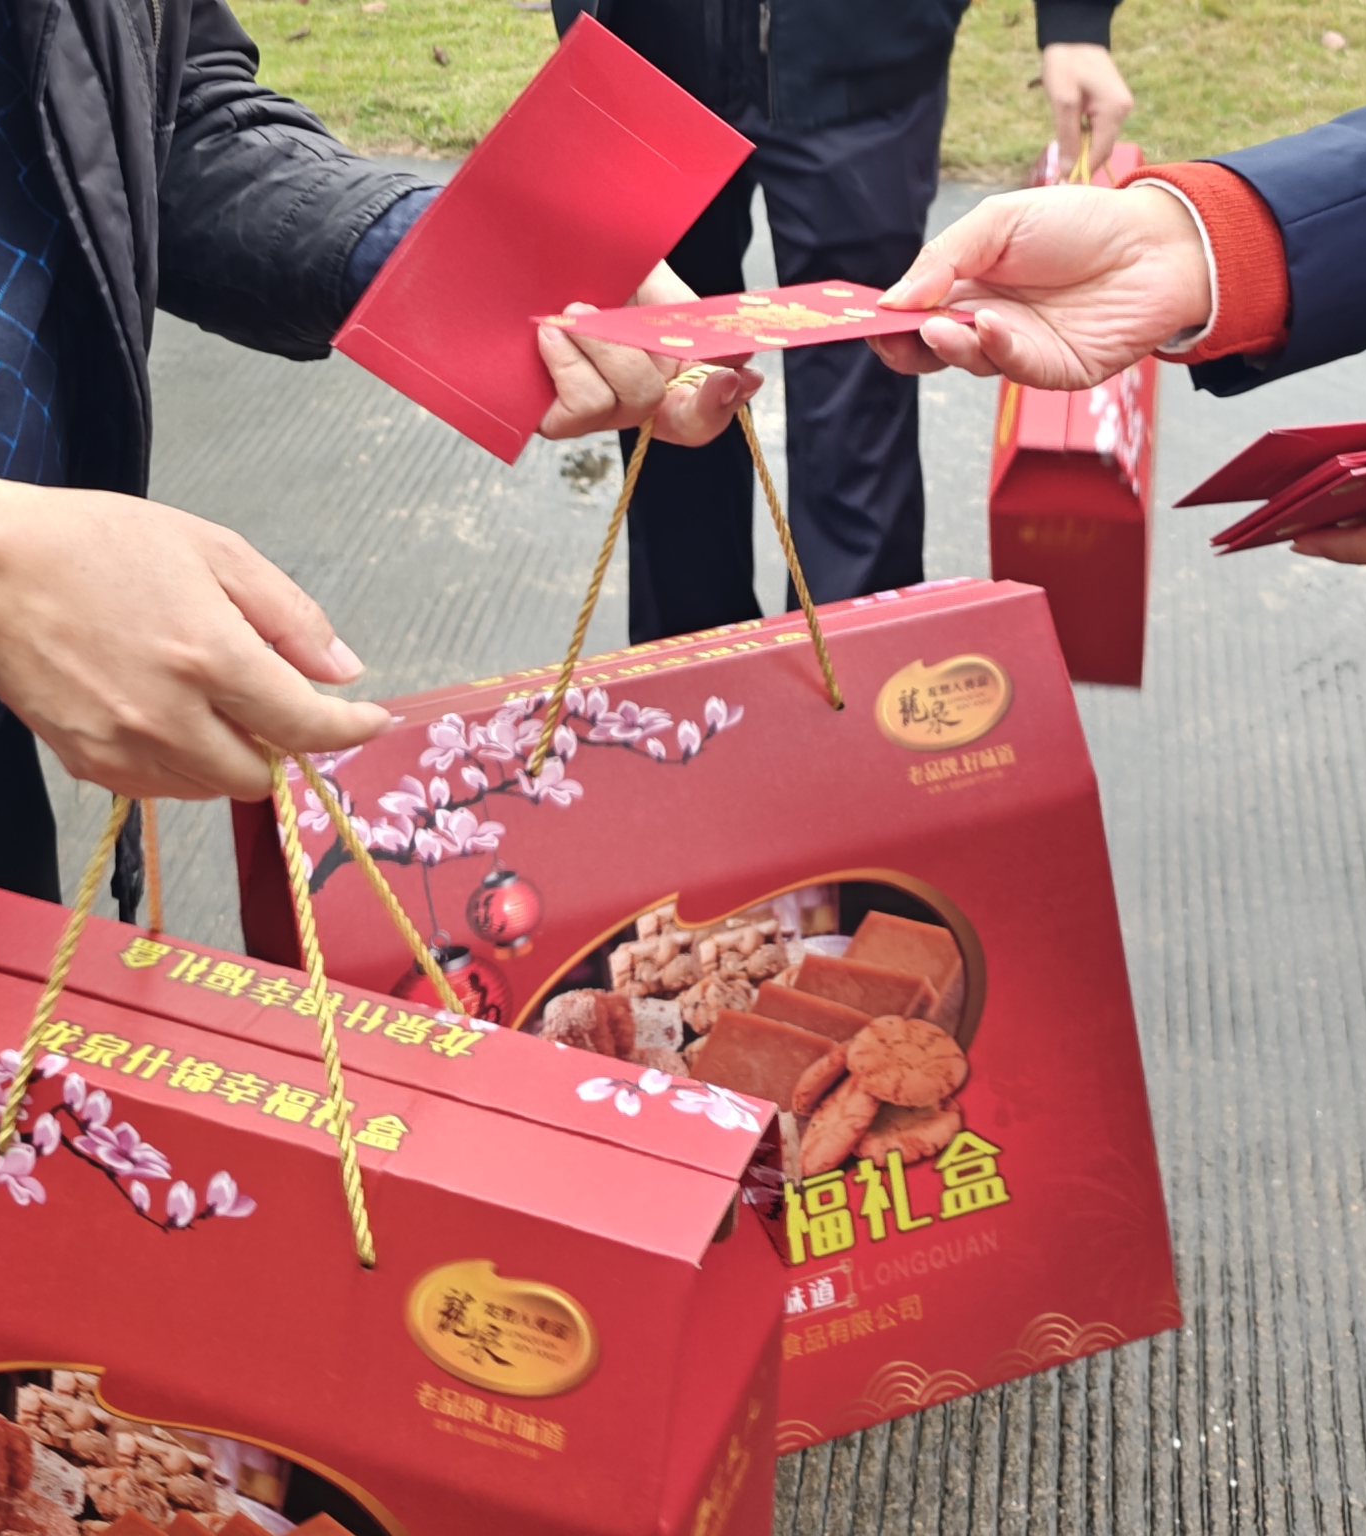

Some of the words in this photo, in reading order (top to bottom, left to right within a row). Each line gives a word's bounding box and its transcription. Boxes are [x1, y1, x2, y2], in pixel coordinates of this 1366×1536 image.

[783, 1130, 1011, 1265] 福礼盒
[858, 1230, 1001, 1292] LONGQUAN
